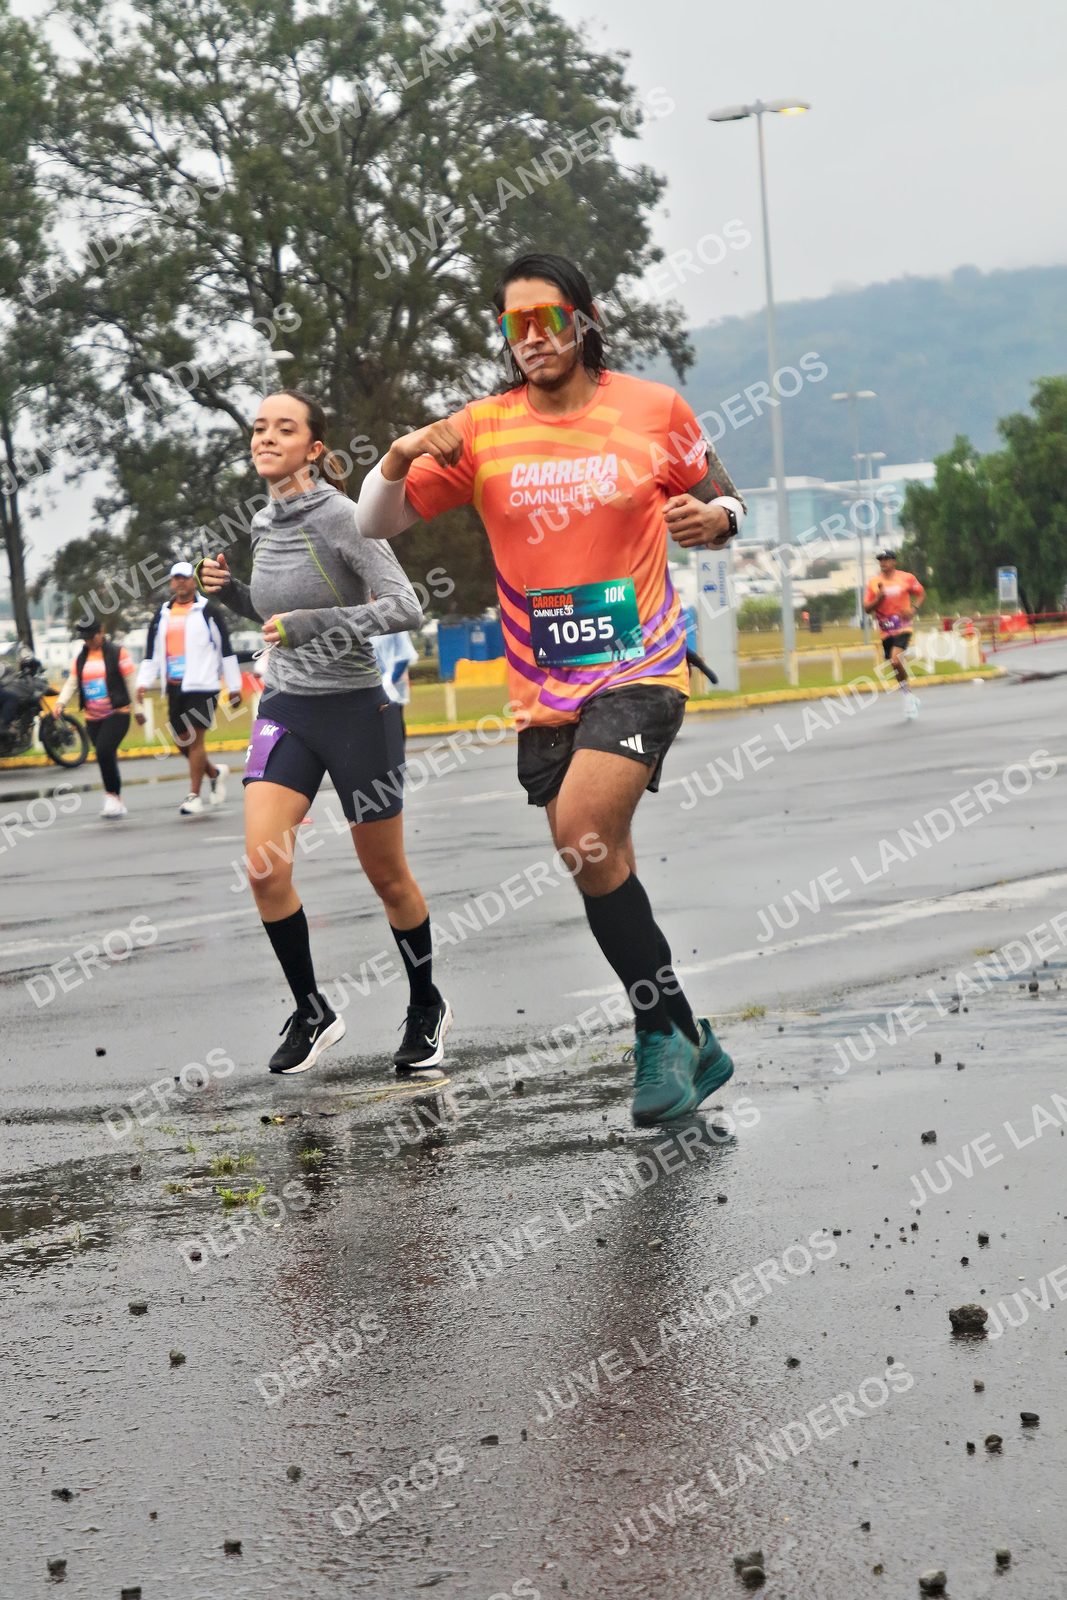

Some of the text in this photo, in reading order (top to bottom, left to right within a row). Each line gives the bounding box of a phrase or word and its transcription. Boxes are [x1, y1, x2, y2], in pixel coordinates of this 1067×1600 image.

[511, 453, 618, 487] CARRERA
[510, 483, 592, 507] OMNILIFE
[532, 594, 573, 608] CARRERA
[604, 585, 625, 604] 10K
[533, 608, 564, 618] OMNILIFE
[548, 616, 614, 645] 1055
